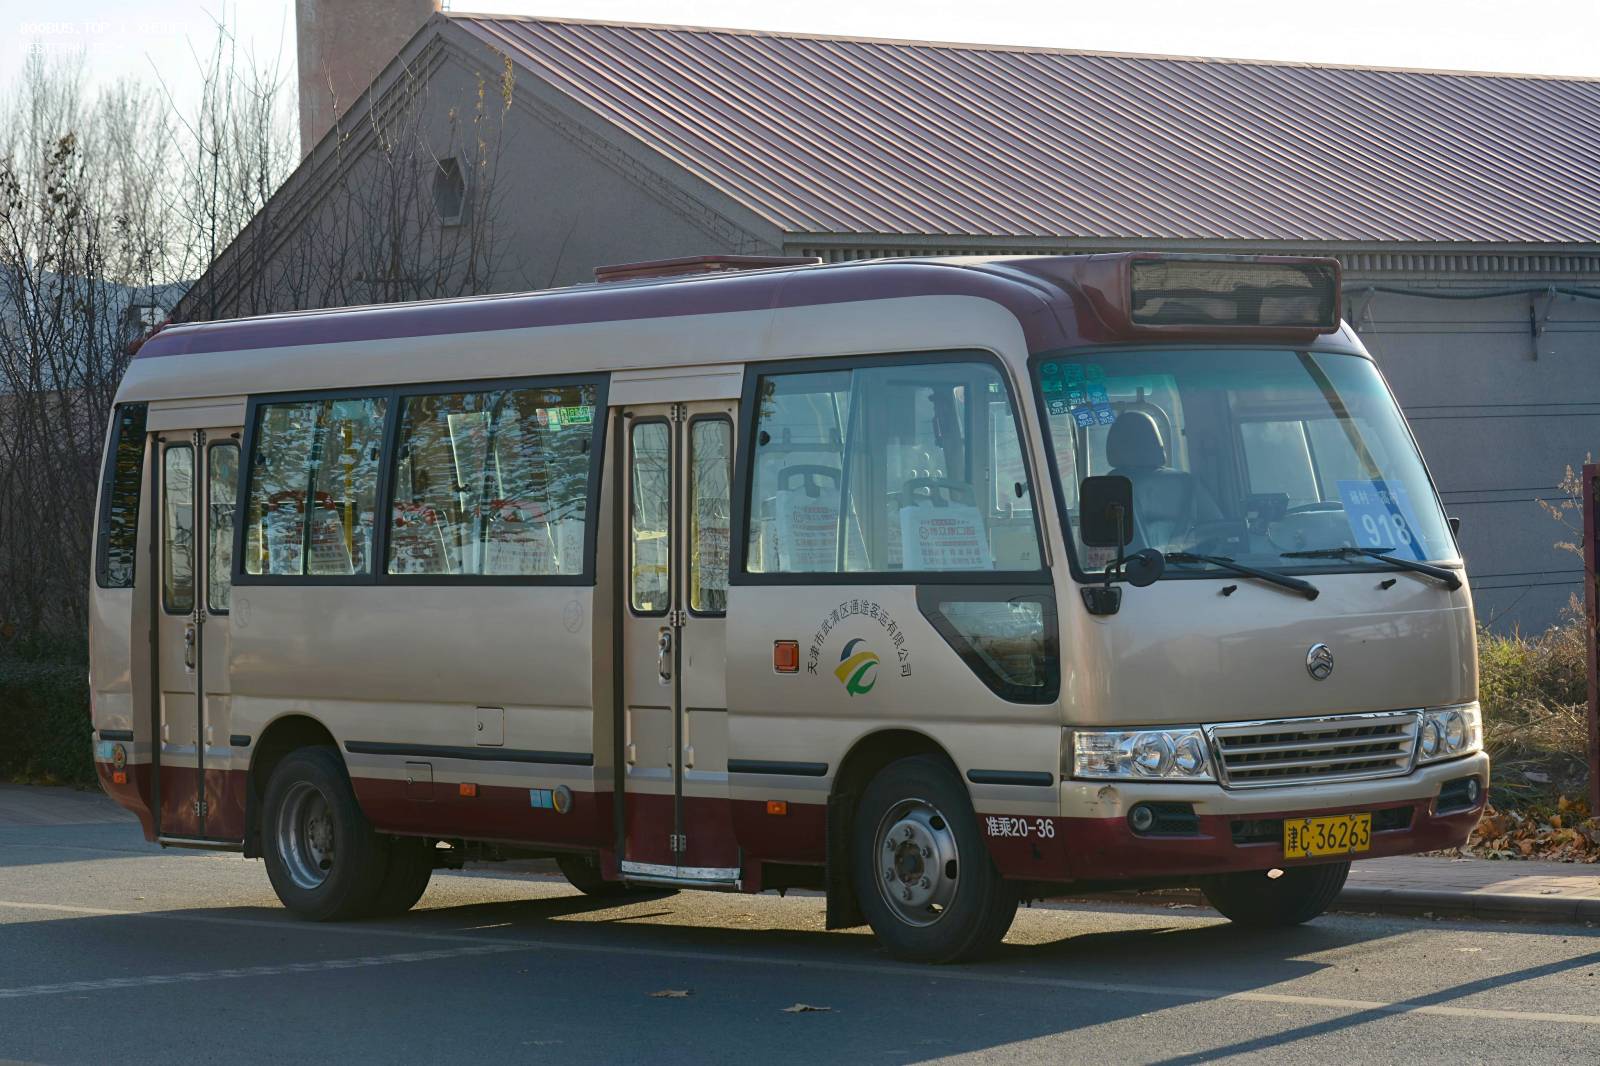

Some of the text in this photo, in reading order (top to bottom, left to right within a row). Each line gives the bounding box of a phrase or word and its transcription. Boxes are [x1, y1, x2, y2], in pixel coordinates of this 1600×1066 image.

[1361, 513, 1411, 546] 918
[807, 599, 912, 677] 天津市武清区通途客运有限公司
[985, 816, 1055, 838] 准乘20-36
